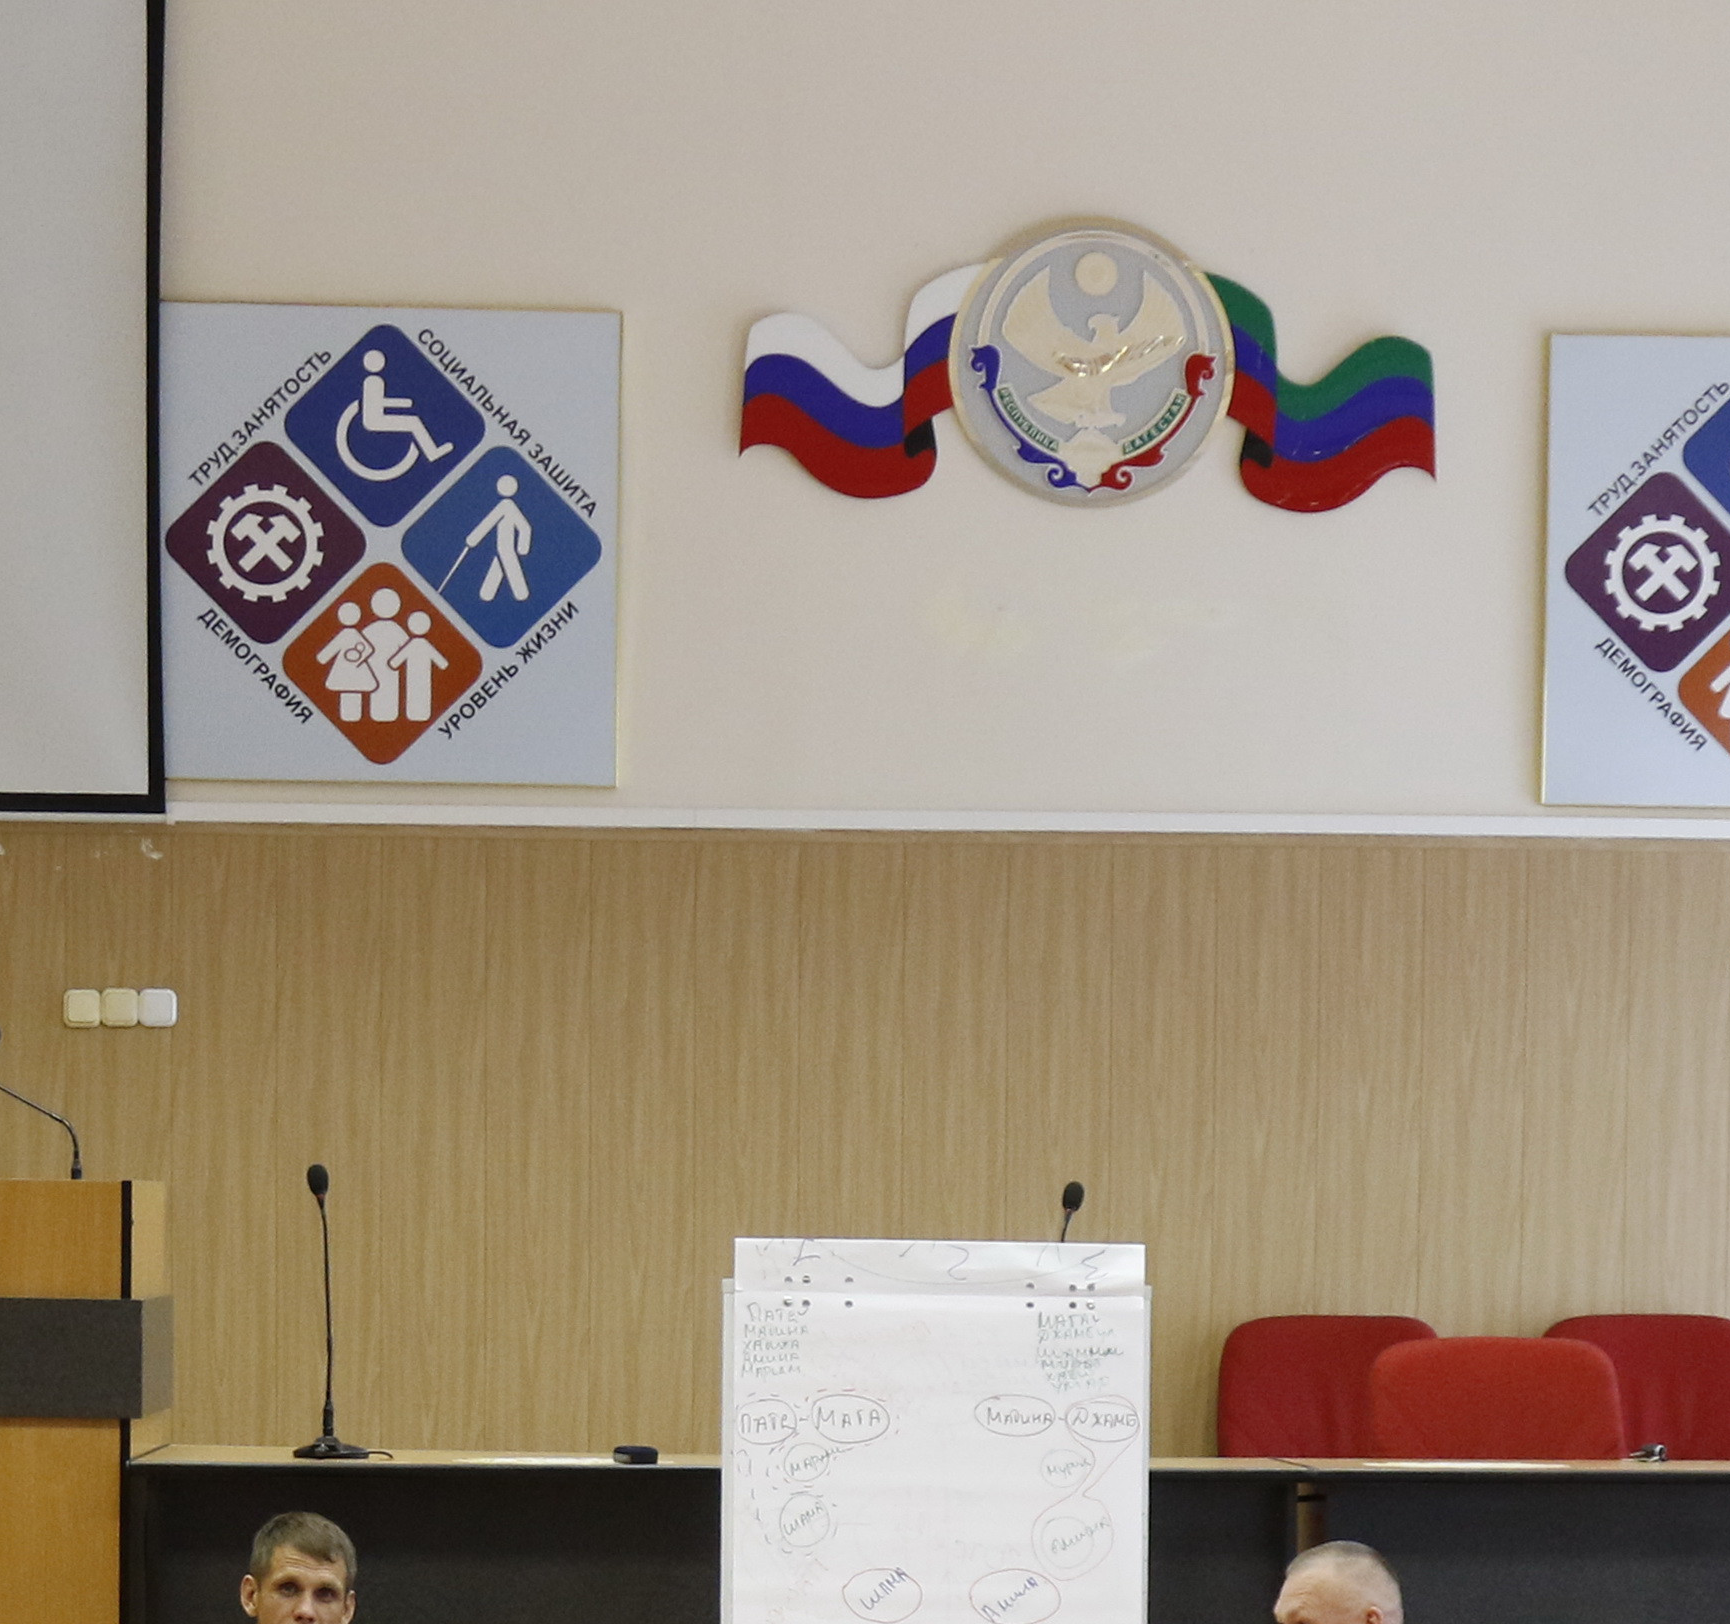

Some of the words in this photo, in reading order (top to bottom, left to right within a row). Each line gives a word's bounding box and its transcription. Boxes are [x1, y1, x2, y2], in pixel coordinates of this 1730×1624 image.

[416, 328, 530, 447] СОЦИАЛЬНАЯ
[196, 607, 315, 726] ДЕМОГРАФИЯ
[437, 661, 520, 740] УРОВЕНЬ
[515, 600, 581, 665] ЖИЗНИ
[1594, 636, 1709, 753] ДЕМОГРАФИЯ
